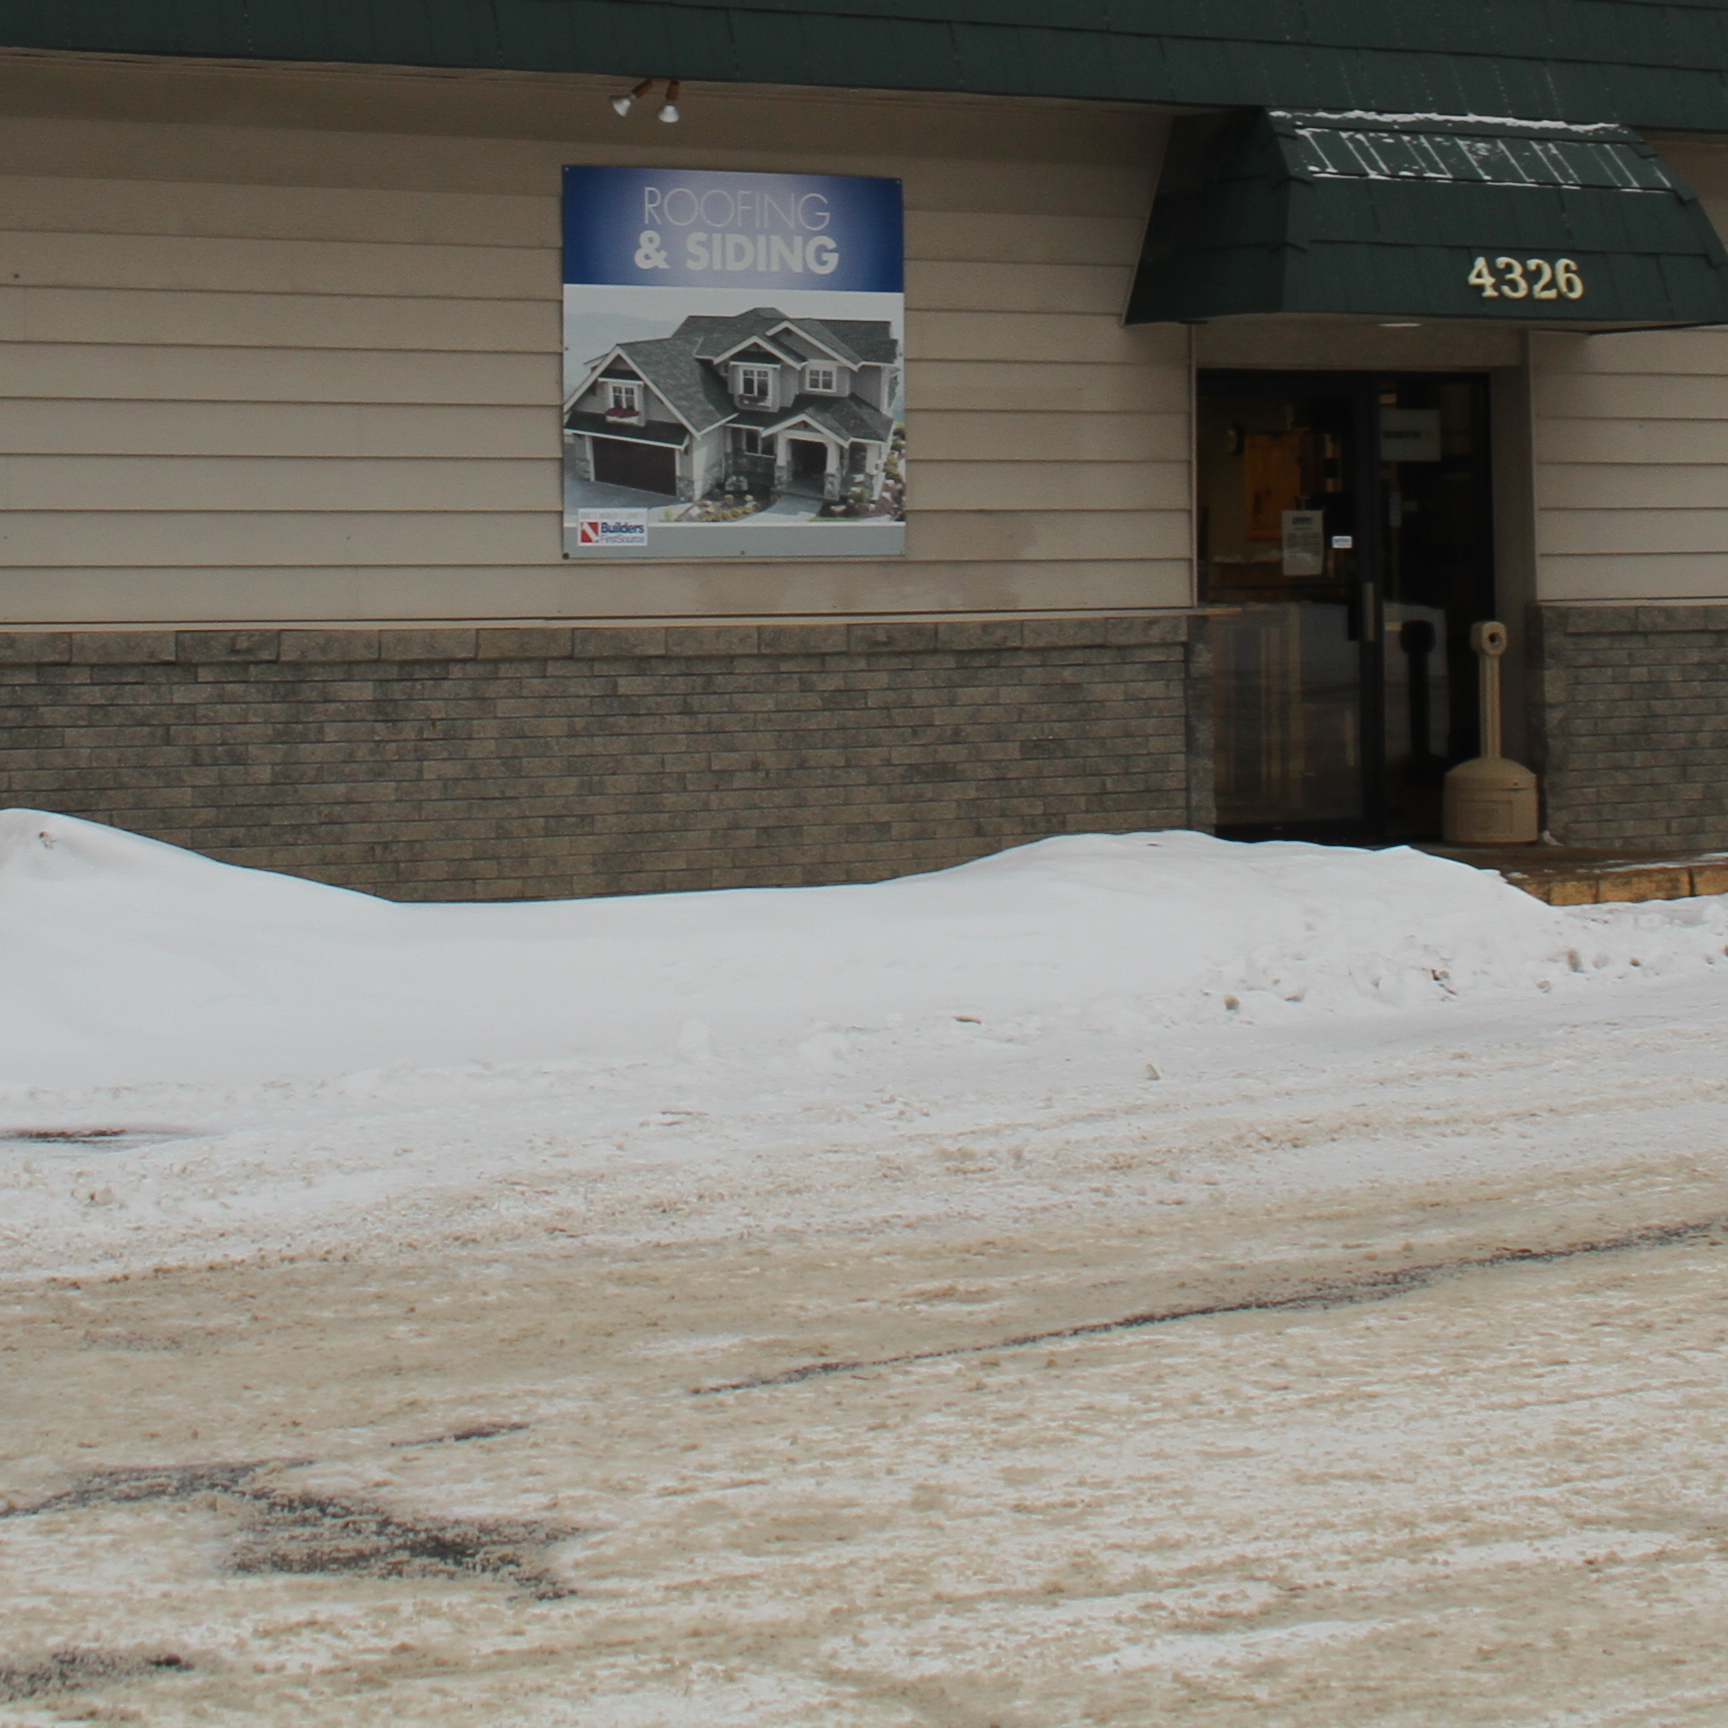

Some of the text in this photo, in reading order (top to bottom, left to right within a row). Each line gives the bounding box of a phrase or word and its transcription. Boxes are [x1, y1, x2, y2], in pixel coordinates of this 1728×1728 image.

[643, 187, 830, 231] ROOFING
[634, 230, 839, 275] & SIDING
[1467, 256, 1584, 301] 4326
[601, 521, 645, 534] Builders
